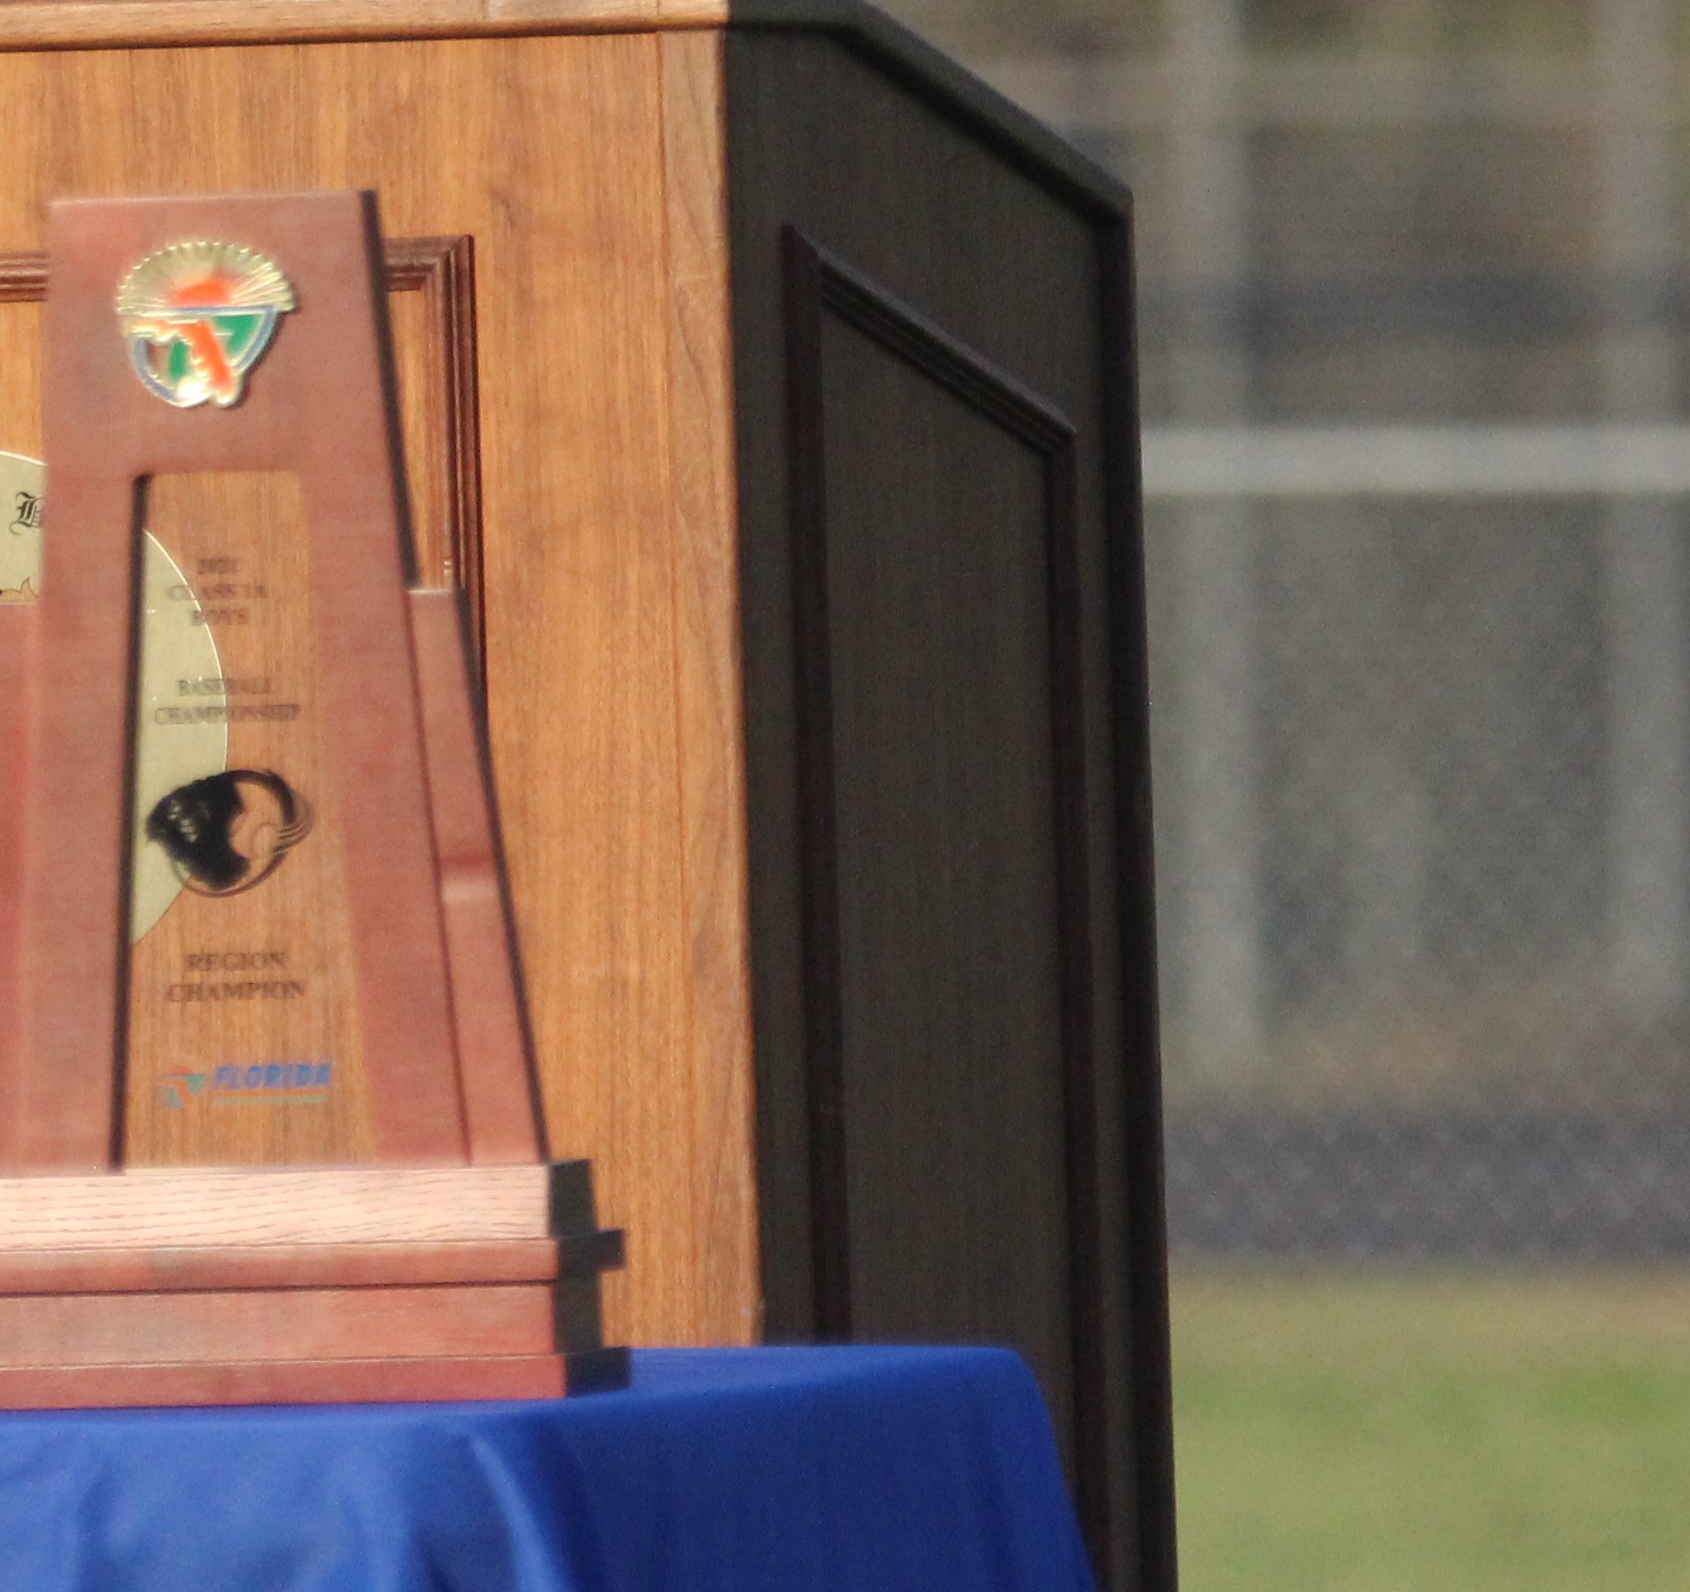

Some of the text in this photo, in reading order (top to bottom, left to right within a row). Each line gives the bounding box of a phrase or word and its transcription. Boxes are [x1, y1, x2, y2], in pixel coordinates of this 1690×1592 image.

[186, 952, 287, 972] REGION
[164, 981, 305, 1002] CHAMPION
[214, 1063, 331, 1090] FLORIDA
